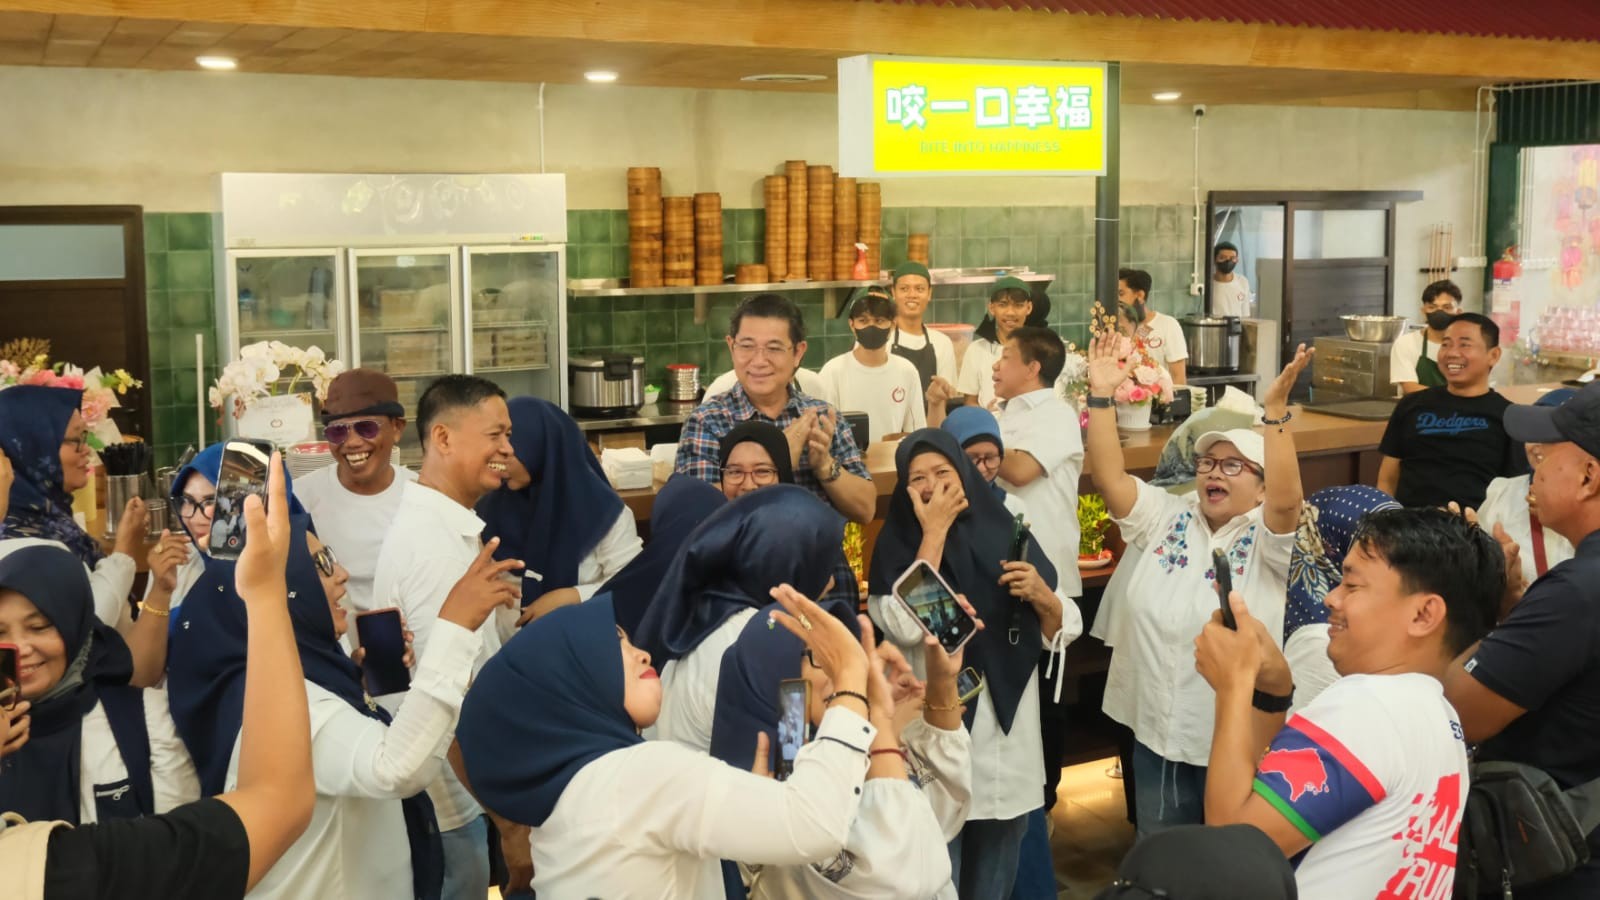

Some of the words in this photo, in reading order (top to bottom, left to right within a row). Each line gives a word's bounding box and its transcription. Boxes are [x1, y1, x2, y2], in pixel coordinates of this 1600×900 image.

[886, 84, 1092, 130] 咬一口幸福
[920, 140, 949, 153] BITE
[953, 140, 985, 153] INTO
[989, 140, 1060, 153] HAPPINESS
[1416, 411, 1488, 436] Dodgers
